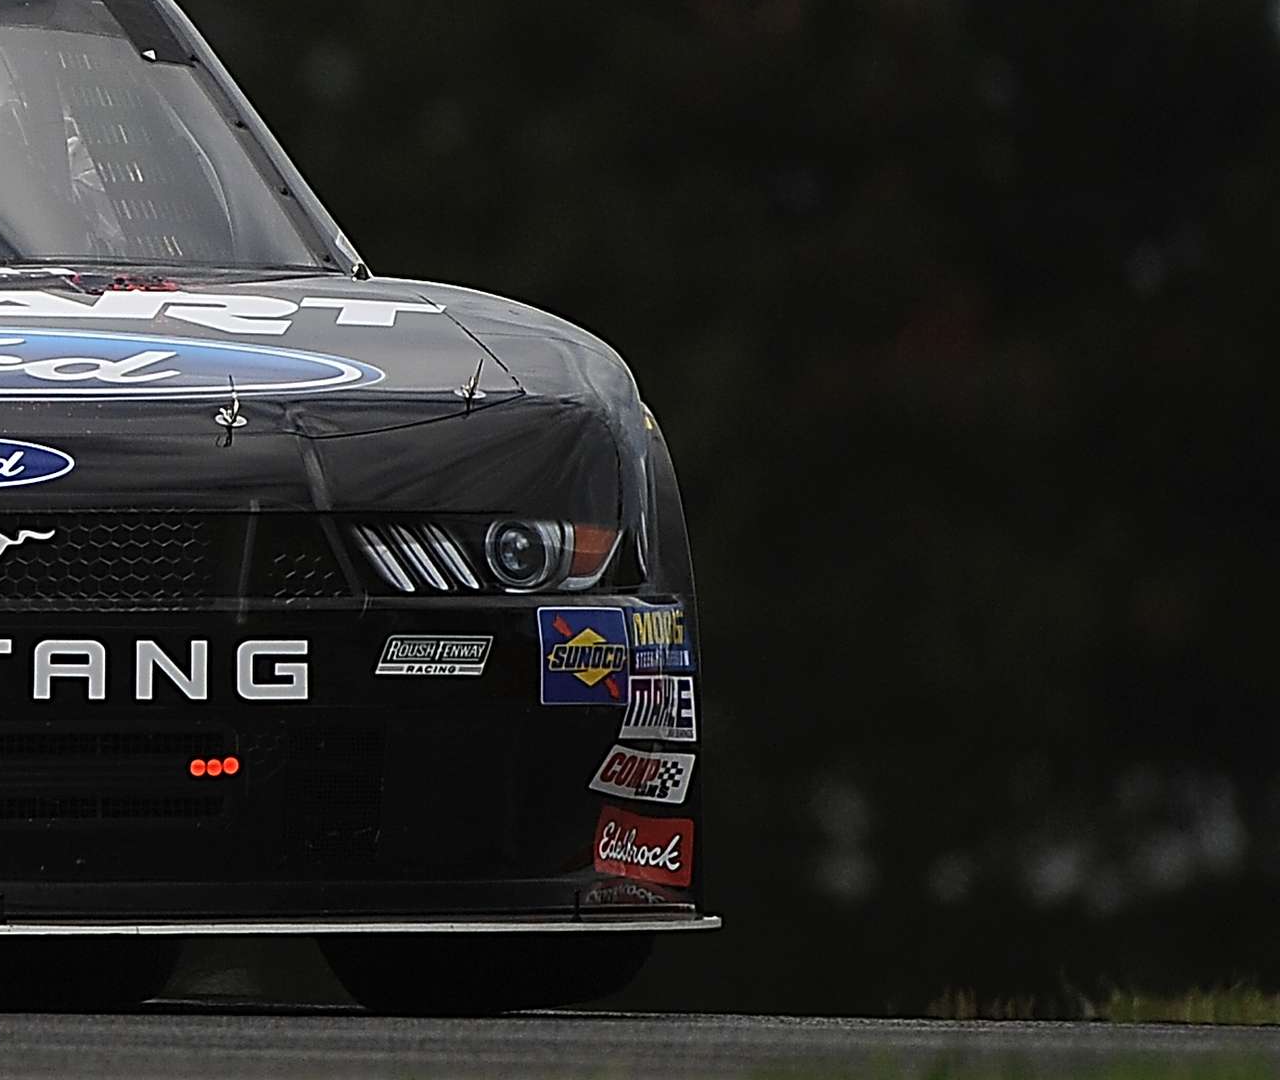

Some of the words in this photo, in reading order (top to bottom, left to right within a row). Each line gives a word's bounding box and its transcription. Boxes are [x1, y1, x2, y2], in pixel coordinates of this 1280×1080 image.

[386, 640, 437, 661] ROUSH
[434, 640, 487, 661] FENWAY
[550, 644, 625, 670] SUNOCO
[405, 665, 457, 674] RACING
[599, 751, 663, 791] COMP
[598, 821, 682, 871] Edelbrock
